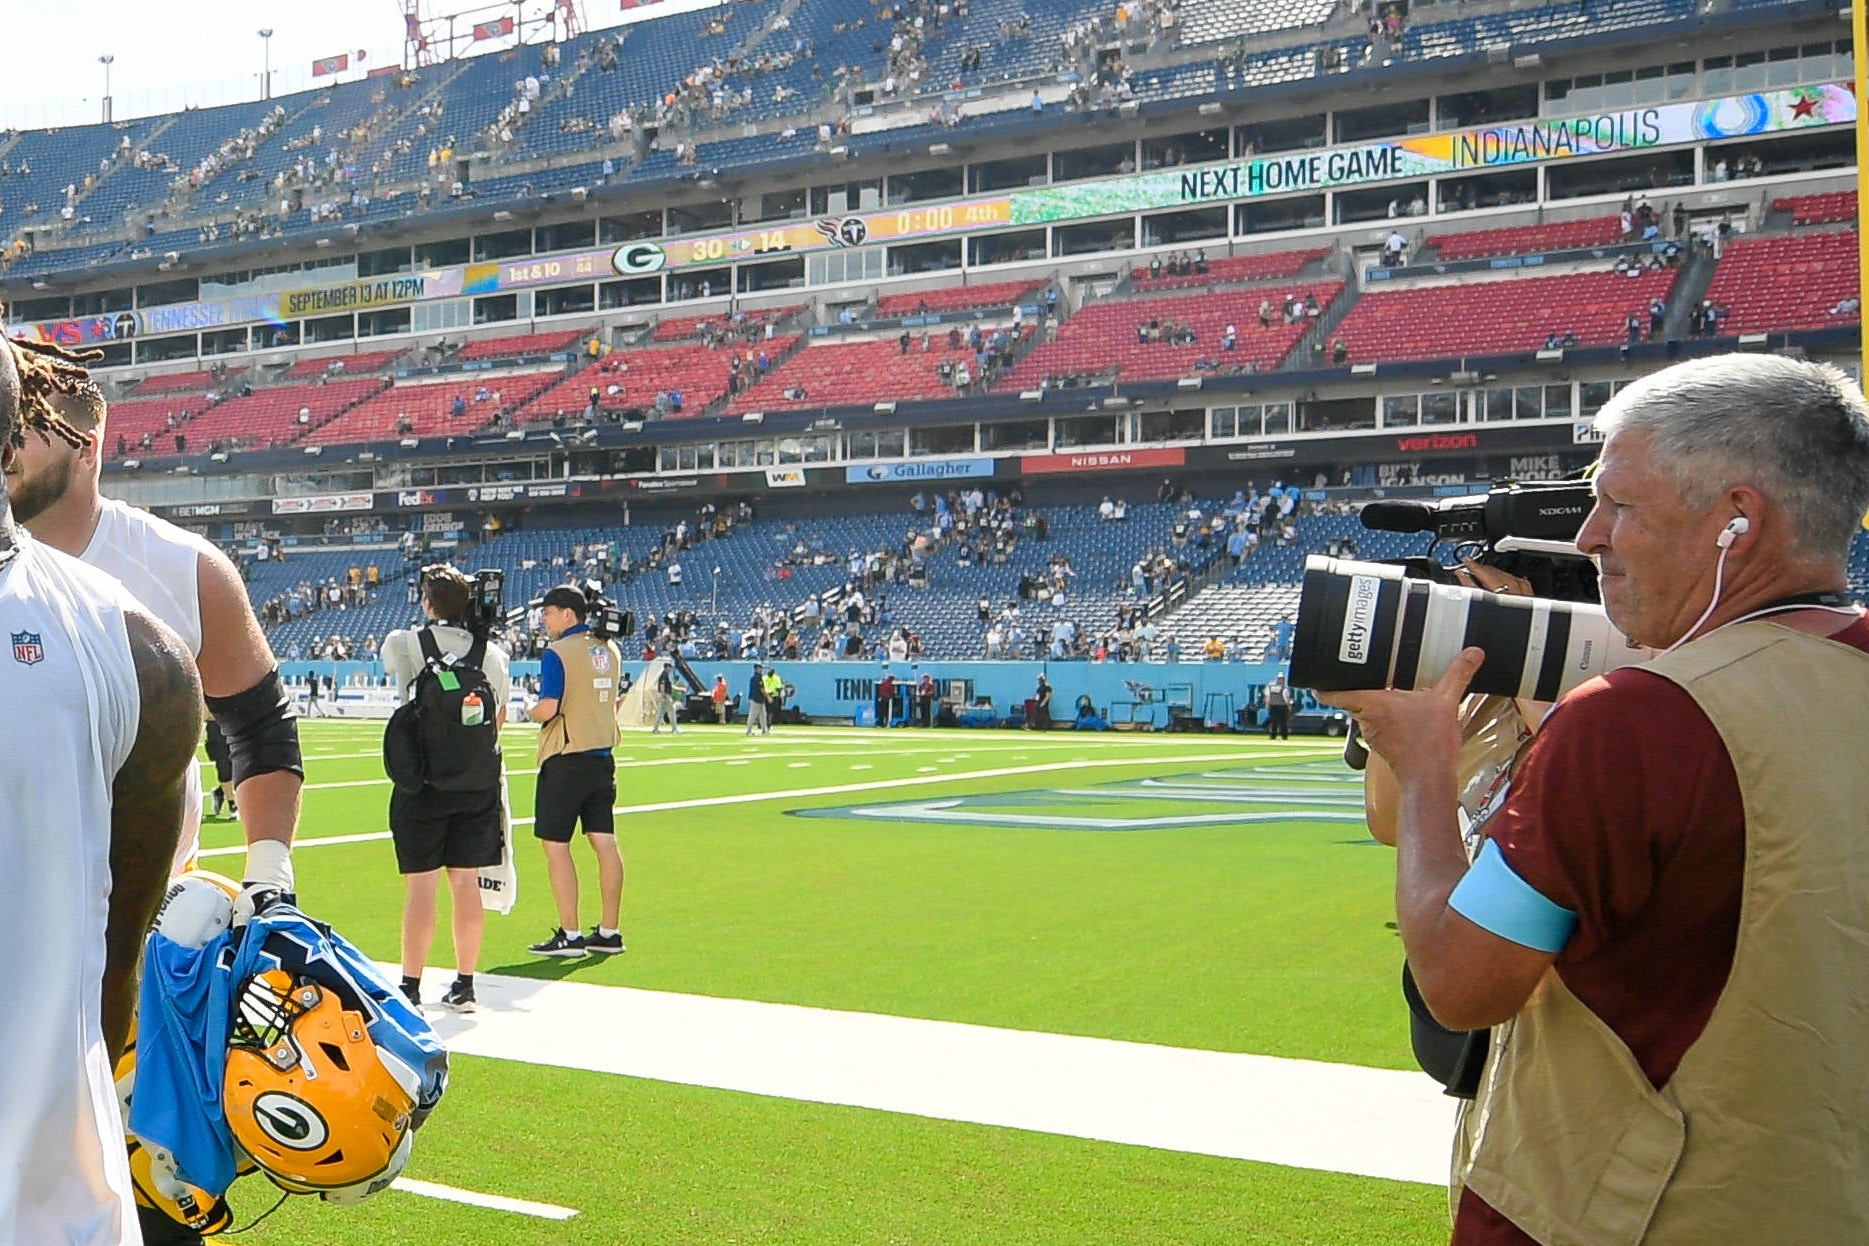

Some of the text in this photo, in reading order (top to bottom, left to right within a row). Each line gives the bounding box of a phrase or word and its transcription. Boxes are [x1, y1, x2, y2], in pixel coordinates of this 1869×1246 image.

[1450, 109, 1661, 168] INDIANAPOLIS
[1181, 146, 1404, 200] NEXT HOME GAME
[692, 239, 723, 261] 30
[759, 232, 785, 252] 14
[288, 286, 356, 313] SEPTEMBER
[358, 286, 372, 305] 13
[374, 284, 389, 302] AT
[391, 278, 424, 299] 12PM
[37, 320, 83, 346] VS
[1398, 433, 1479, 452] verizon
[1071, 454, 1132, 467] NISSAN
[1510, 455, 1560, 472] MIKE
[770, 471, 803, 484] WM
[894, 461, 971, 480] Gallagher
[398, 490, 435, 506] FedEx
[179, 504, 220, 517] BETMGM
[1346, 577, 1373, 661] gettyimages
[16, 645, 42, 662] NFL
